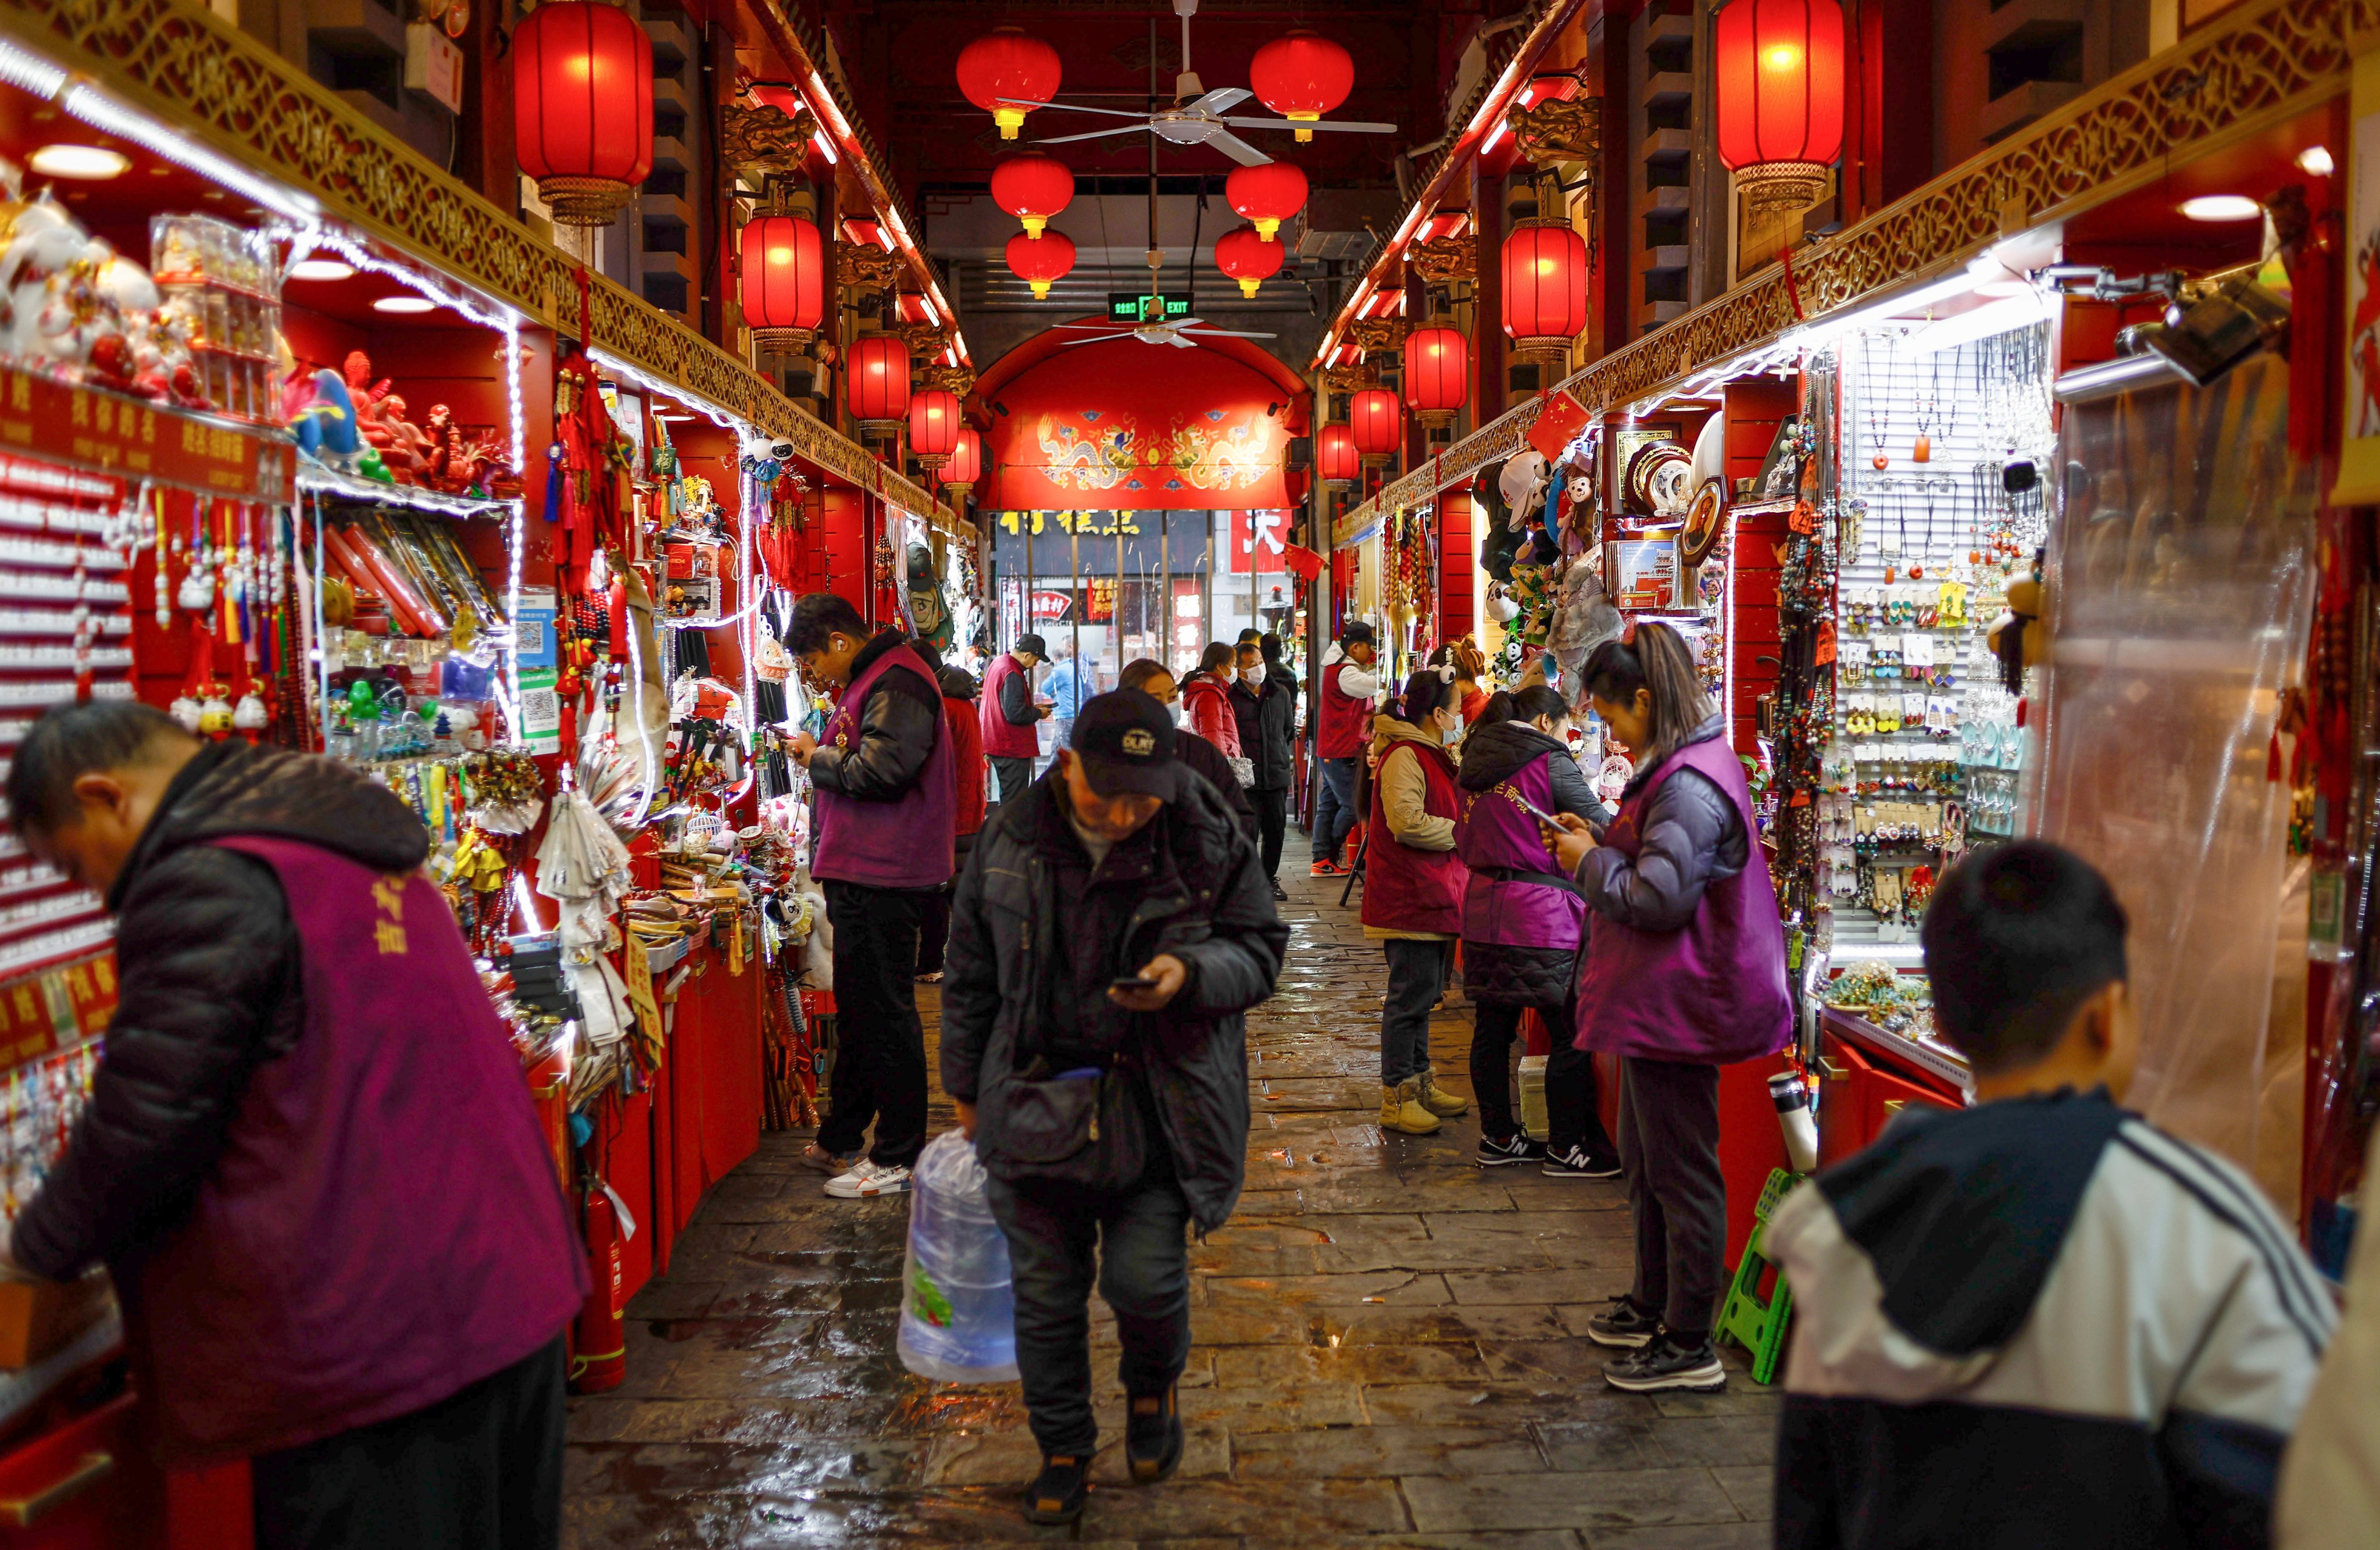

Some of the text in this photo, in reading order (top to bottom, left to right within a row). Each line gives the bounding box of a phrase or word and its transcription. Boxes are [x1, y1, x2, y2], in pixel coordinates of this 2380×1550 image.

[1114, 302, 1137, 314] 安全出口
[1167, 301, 1188, 313] EXIT
[1571, 1153, 1591, 1169] N
